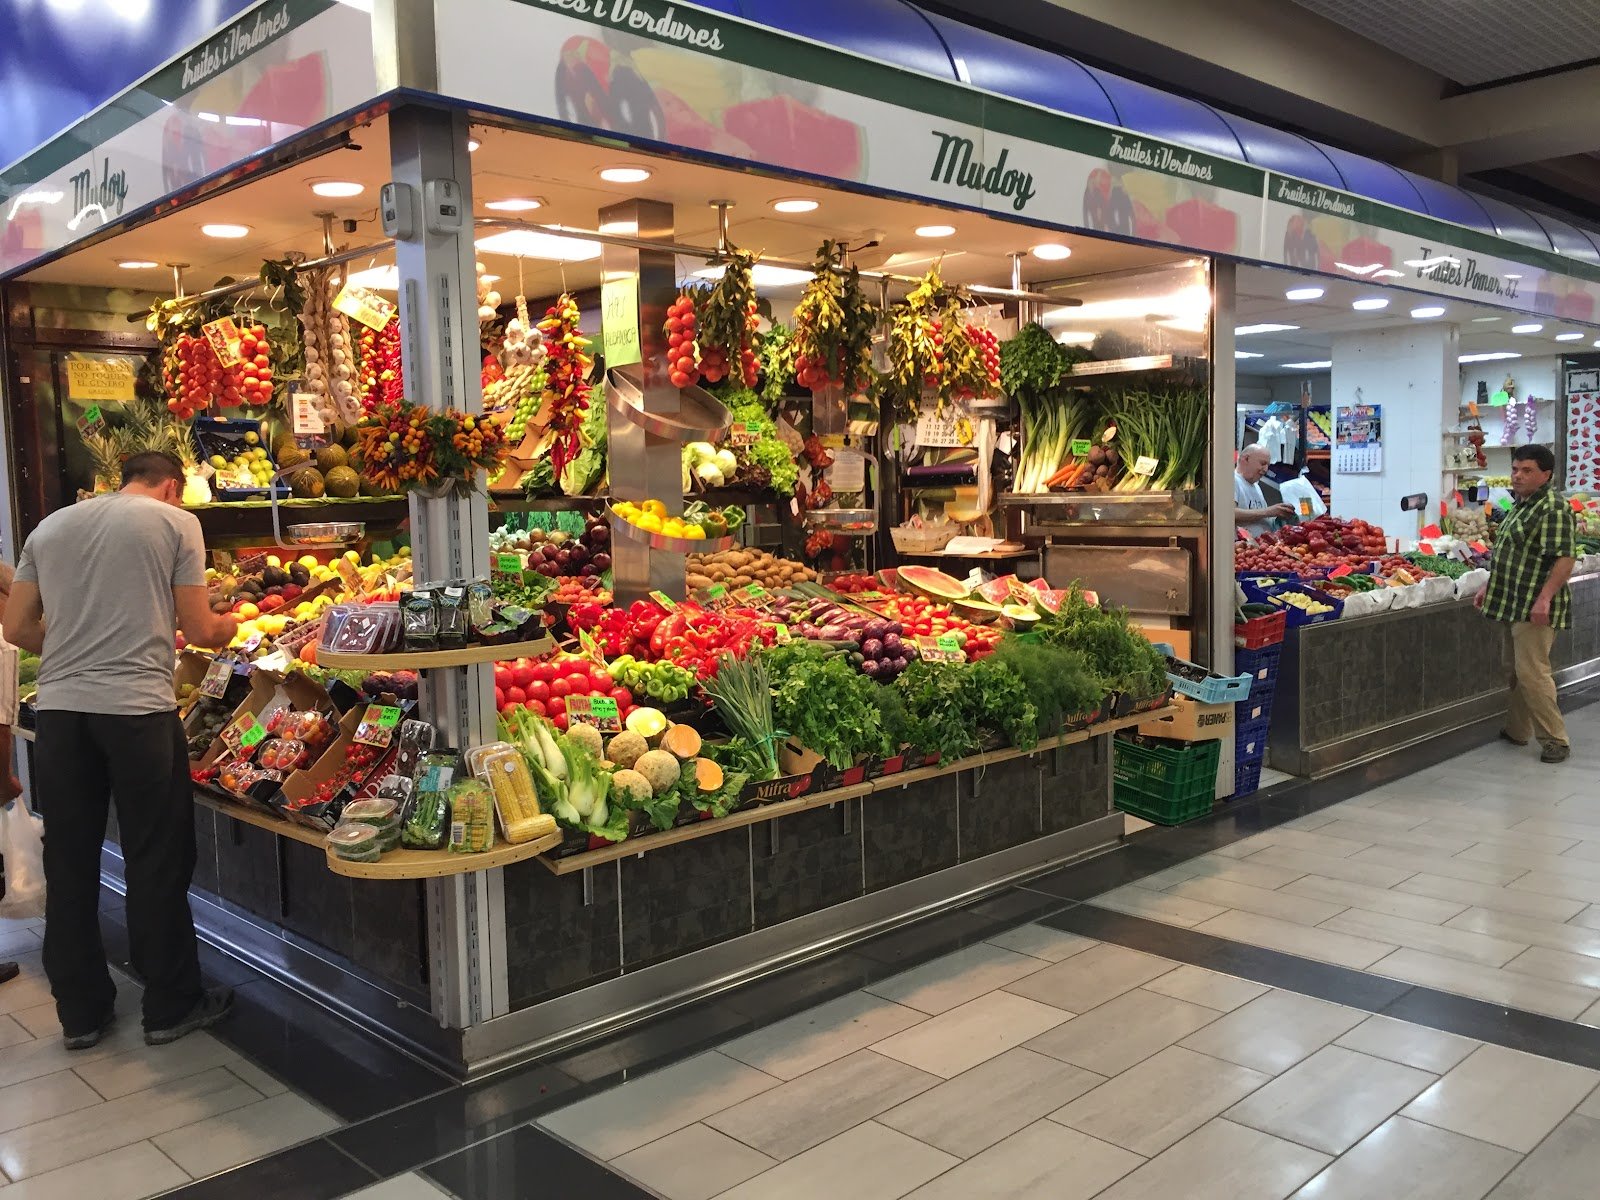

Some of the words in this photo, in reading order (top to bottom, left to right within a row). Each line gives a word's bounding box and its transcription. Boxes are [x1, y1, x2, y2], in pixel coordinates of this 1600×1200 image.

[181, 44, 221, 90] Fruites
[222, 37, 229, 66] i
[228, 3, 290, 60] Verdures
[610, 0, 724, 51] Verdures
[931, 130, 1036, 211] Mudoy
[1109, 134, 1154, 166] Fruites
[1153, 149, 1161, 168] i
[1160, 146, 1214, 181] Verdures
[69, 157, 129, 219] Mudoy
[1278, 179, 1312, 205] Fruites
[1311, 192, 1318, 207] i
[1317, 189, 1356, 217] Verdures
[71, 362, 91, 371] POR
[74, 371, 88, 379] NO
[757, 783, 792, 799] Mifra
